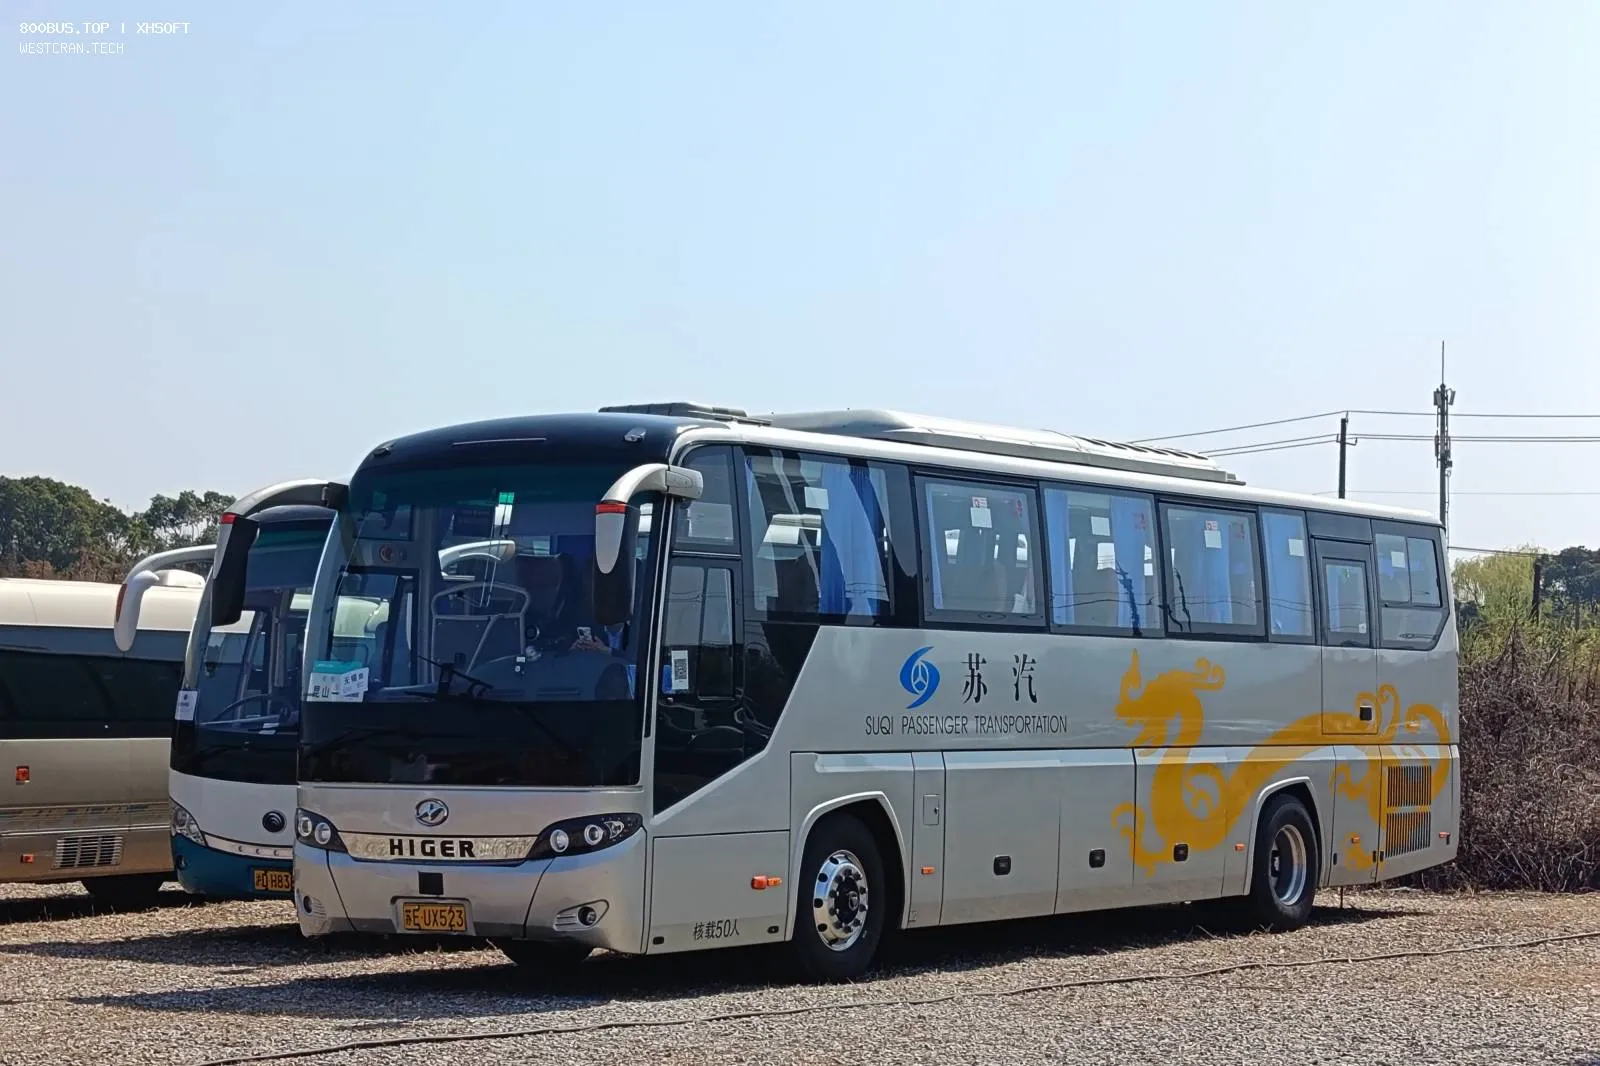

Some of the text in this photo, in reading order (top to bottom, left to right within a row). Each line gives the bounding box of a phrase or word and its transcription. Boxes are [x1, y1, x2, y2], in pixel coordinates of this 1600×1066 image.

[960, 652, 1038, 703] 苏汽
[865, 715, 1067, 735] SUQI PASSENGER TRANSPORTATION
[389, 838, 476, 858] HIGER
[693, 919, 740, 941] 核载50人
